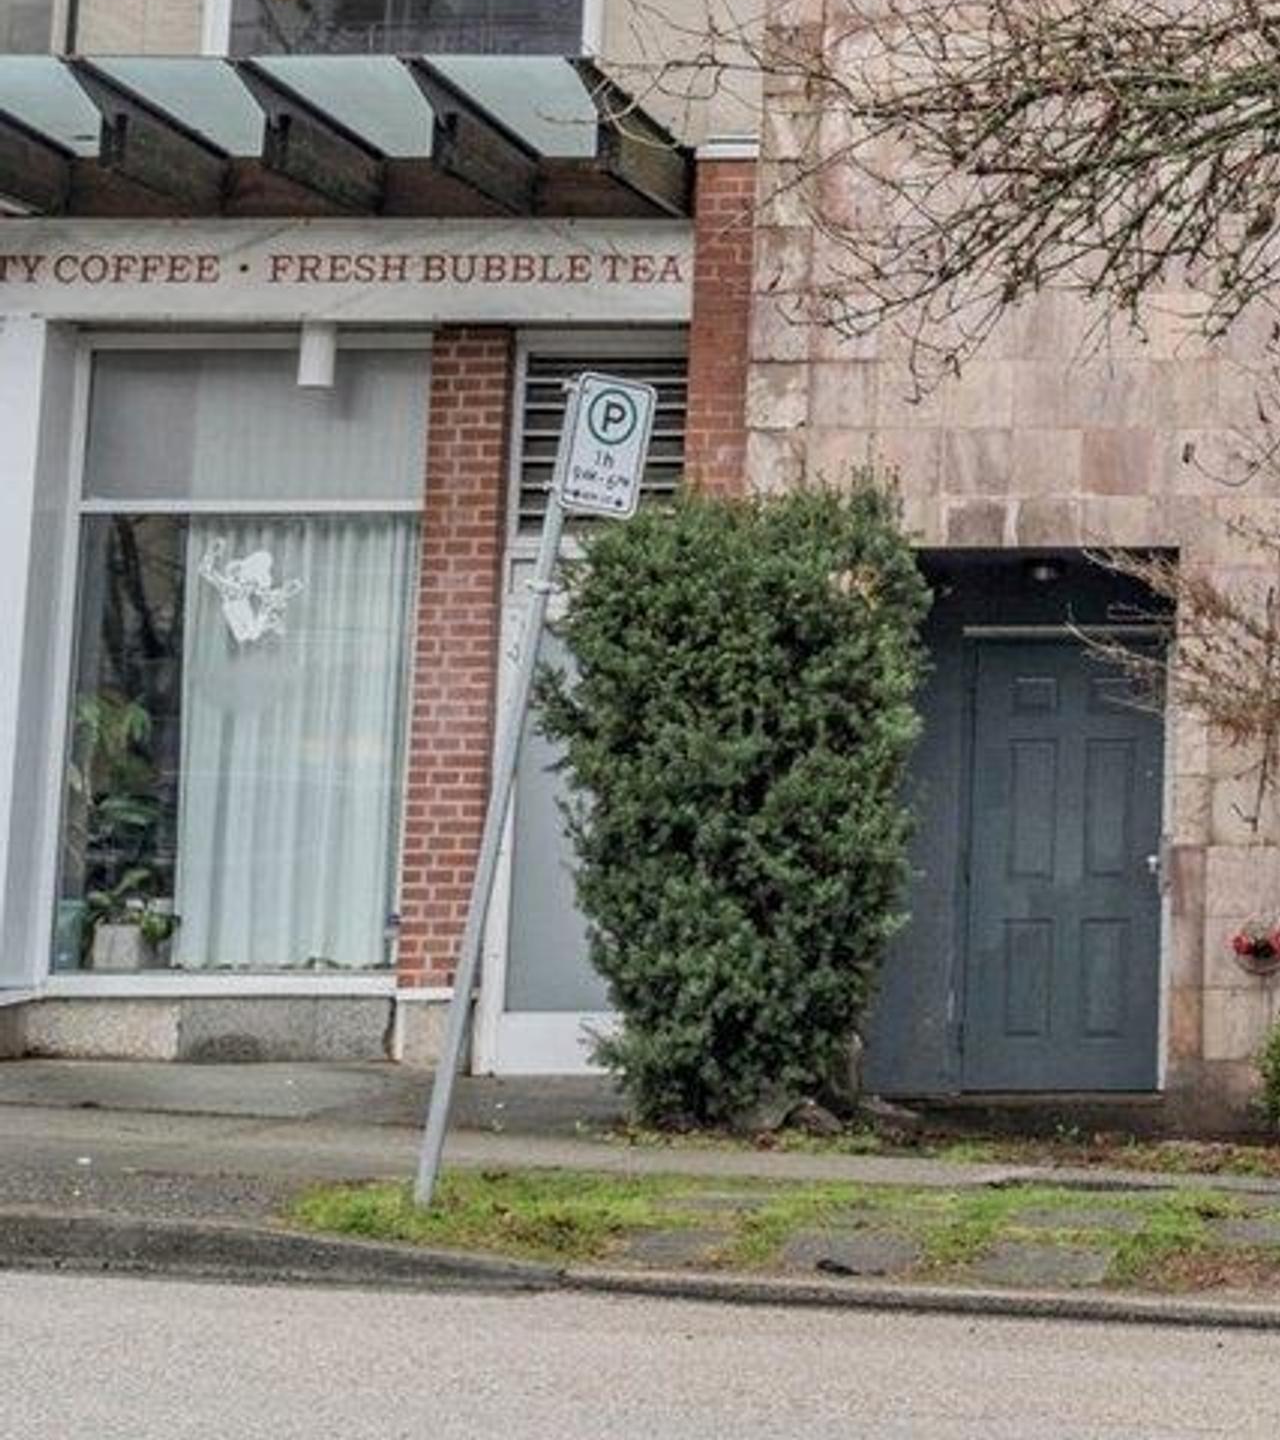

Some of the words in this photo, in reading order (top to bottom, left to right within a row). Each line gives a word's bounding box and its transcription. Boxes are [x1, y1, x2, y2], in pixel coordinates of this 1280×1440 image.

[54, 254, 220, 283] COFFEE
[268, 254, 408, 283] FRESH
[420, 254, 592, 283] BUBBLE
[602, 254, 684, 283] TEA
[602, 399, 627, 433] P
